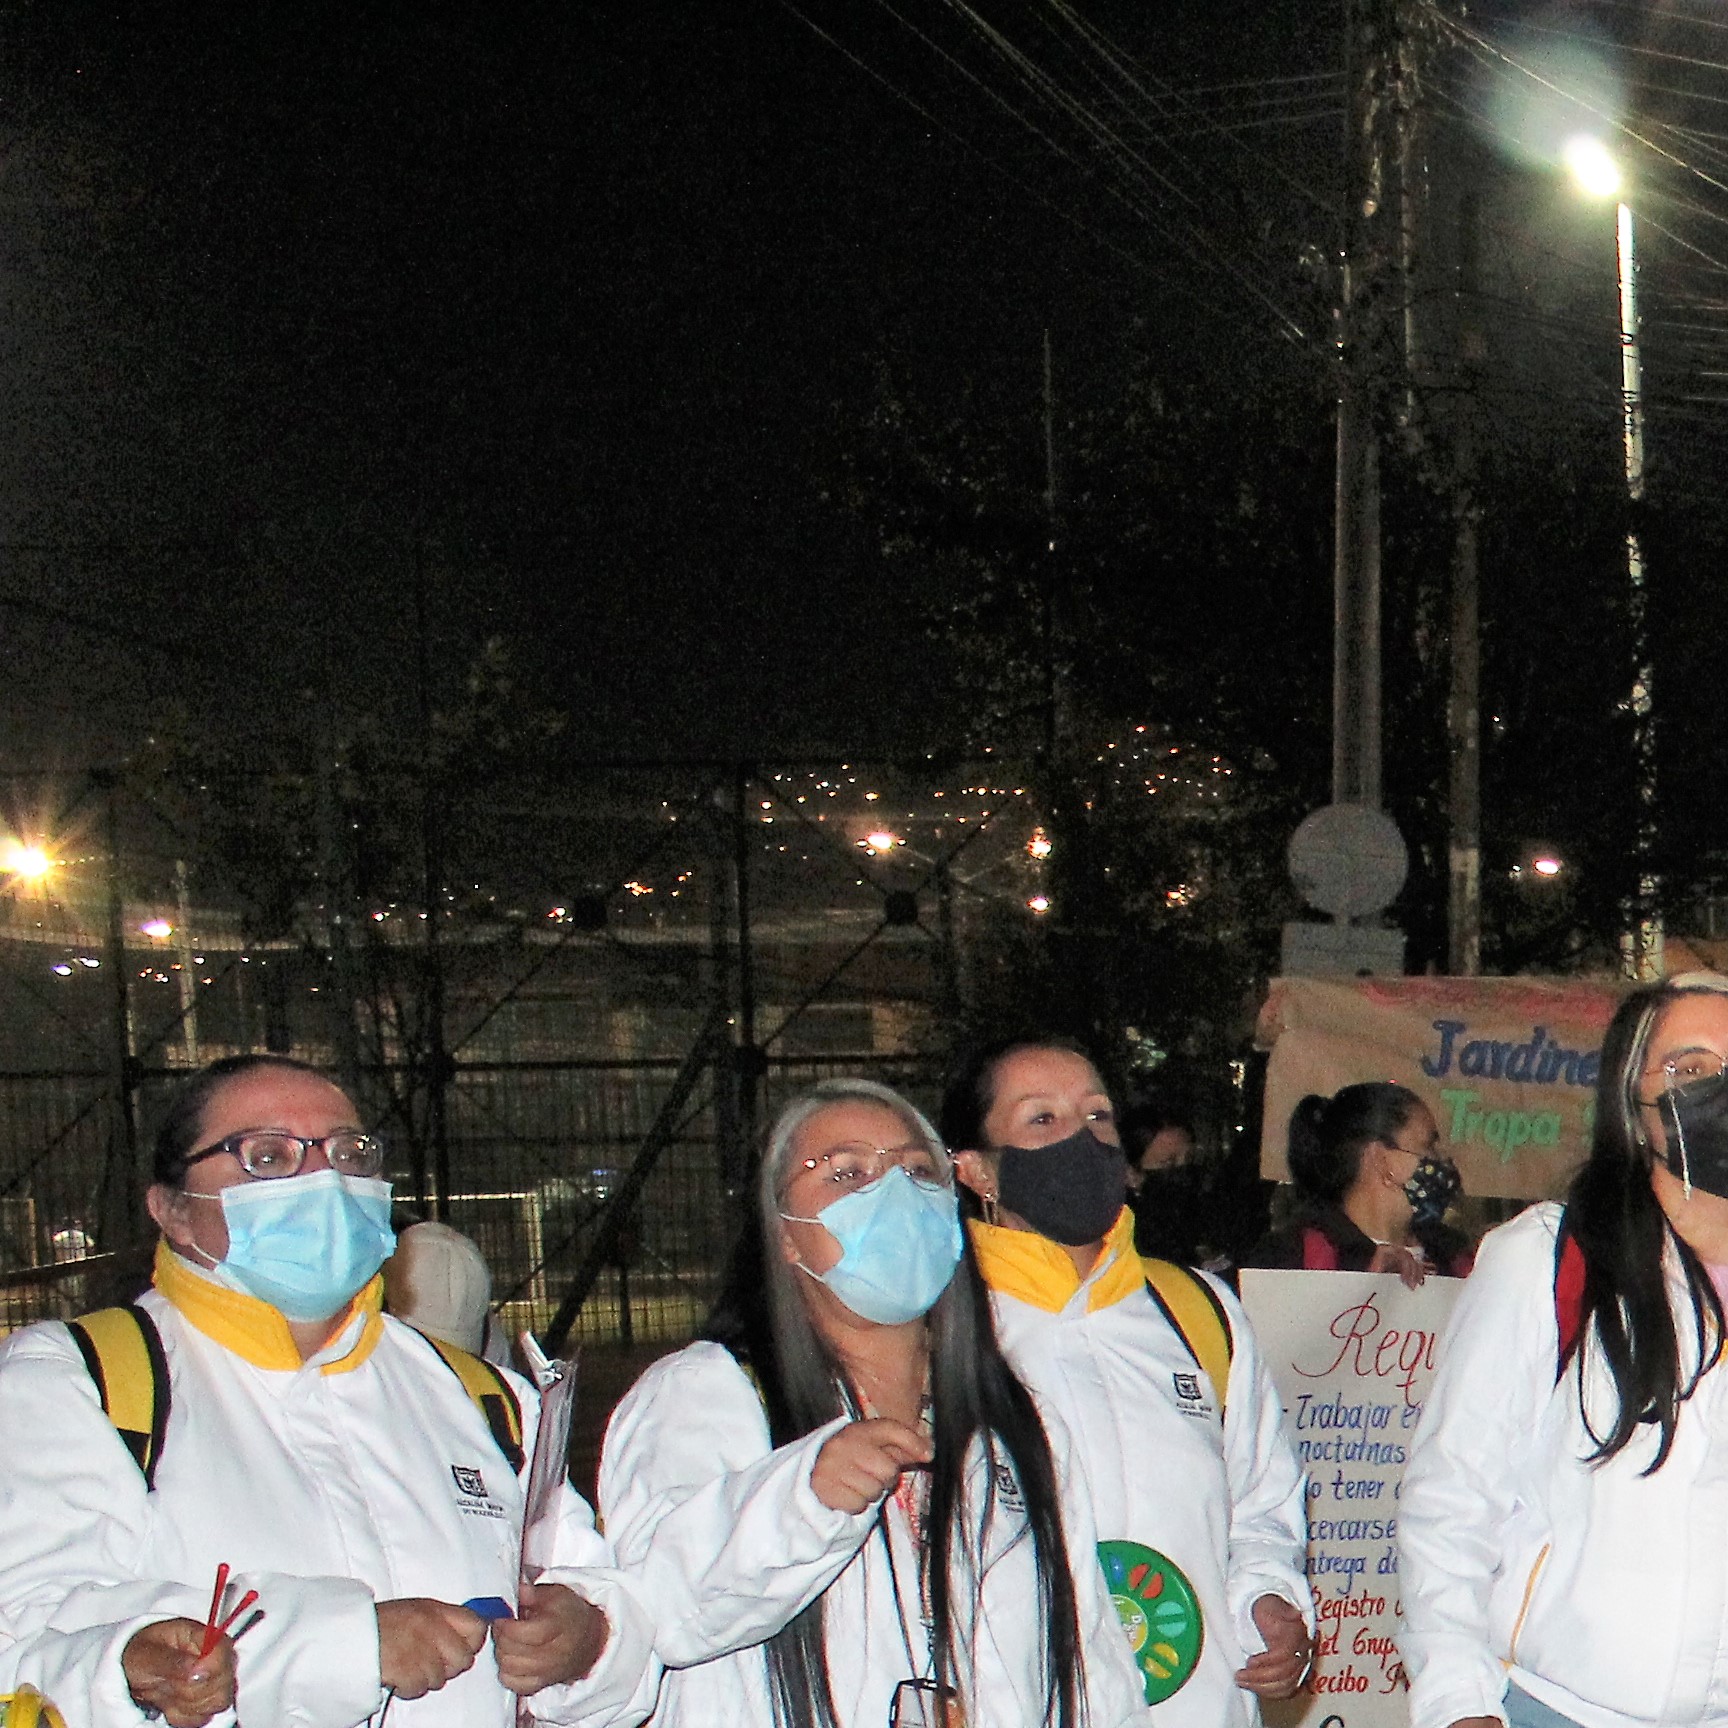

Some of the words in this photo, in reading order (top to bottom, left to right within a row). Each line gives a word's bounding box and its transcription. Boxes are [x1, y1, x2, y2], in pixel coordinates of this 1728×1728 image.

[1296, 1391, 1398, 1444] Trabajar
[1299, 1434, 1407, 1465] nocturnas
[1331, 1469, 1385, 1501] tener
[1307, 1519, 1398, 1541] cercarse
[1305, 1549, 1367, 1596] ntrega
[1353, 1626, 1399, 1670] Grup
